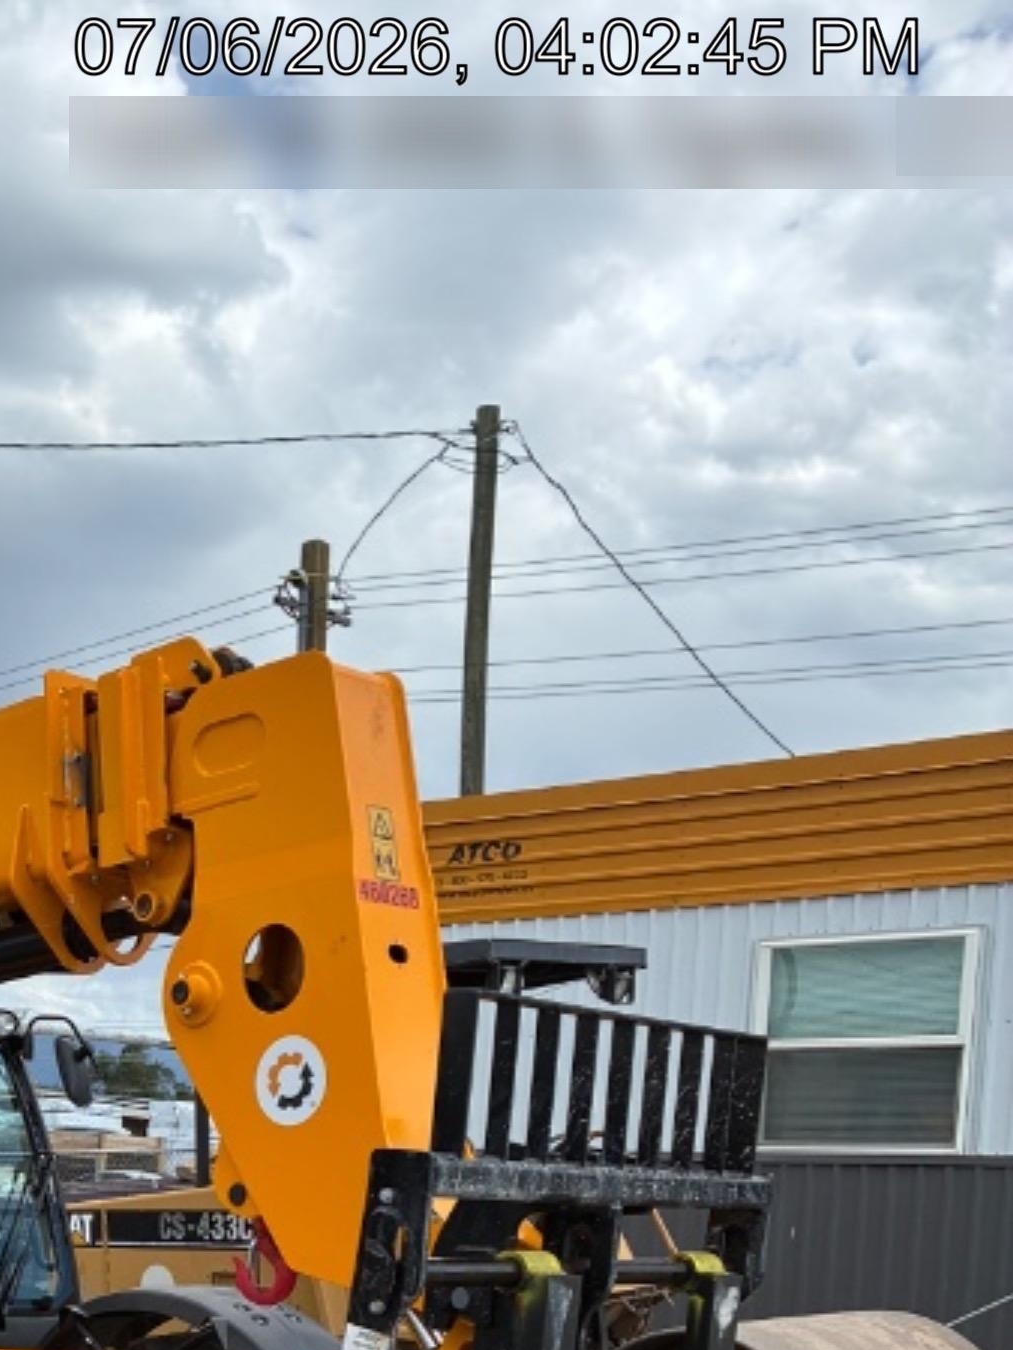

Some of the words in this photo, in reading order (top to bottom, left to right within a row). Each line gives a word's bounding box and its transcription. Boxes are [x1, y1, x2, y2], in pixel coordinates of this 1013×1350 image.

[447, 839, 523, 865] ATCO
[69, 1213, 95, 1246] AT
[159, 1210, 253, 1241] CS-433C
